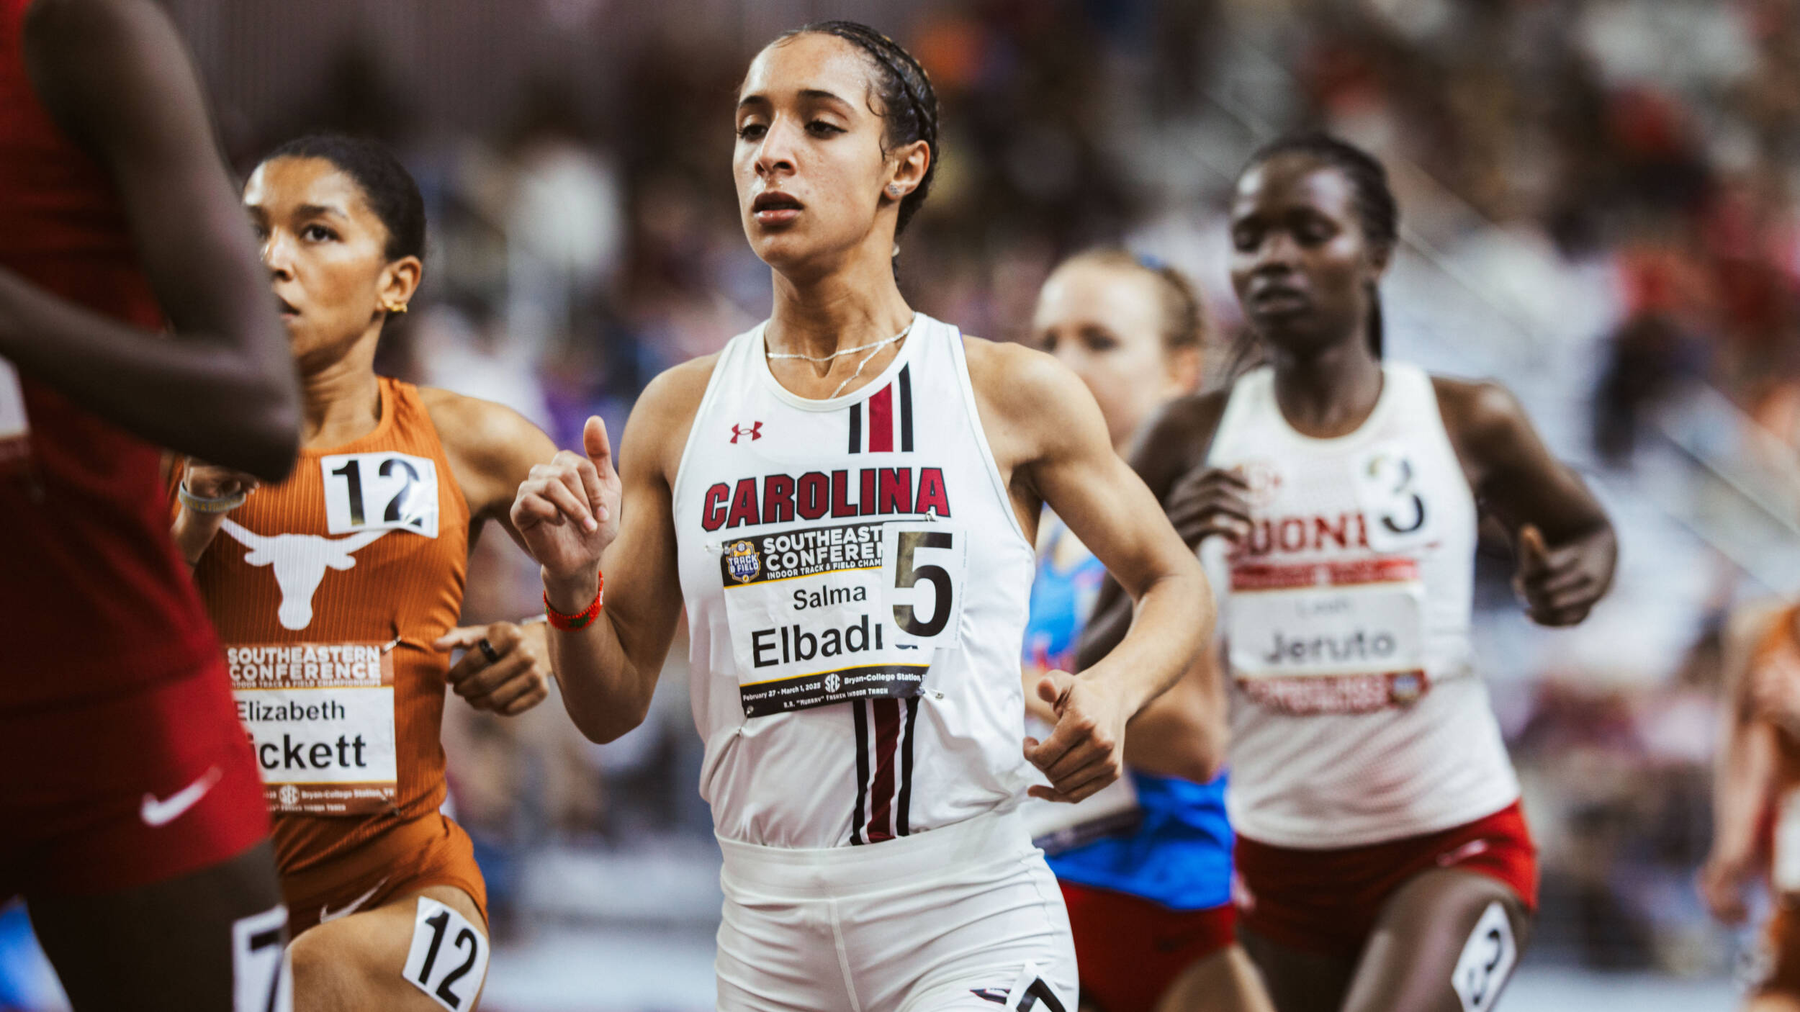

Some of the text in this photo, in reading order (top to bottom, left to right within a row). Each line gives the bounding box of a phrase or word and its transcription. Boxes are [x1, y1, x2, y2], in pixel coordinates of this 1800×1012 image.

[331, 458, 423, 527] 12
[702, 467, 951, 532] CAROLINA
[1367, 453, 1425, 534] 3
[763, 525, 883, 555] SOUTHEAST
[737, 560, 759, 572] FIELD
[767, 568, 798, 580] INDOOR
[801, 564, 825, 575] TRACK
[825, 562, 831, 571] &
[832, 560, 856, 570] FIELD
[858, 558, 882, 567] CHAM
[892, 531, 953, 638] 5
[793, 585, 867, 611] Salma
[227, 645, 381, 666] SOUTHEASTERN
[1263, 631, 1397, 665] Jeruto
[229, 662, 382, 682] CONFERENCE
[824, 673, 841, 694] SEC
[781, 686, 799, 695] March
[237, 700, 346, 722] Elizabeth
[418, 910, 478, 1010] 12
